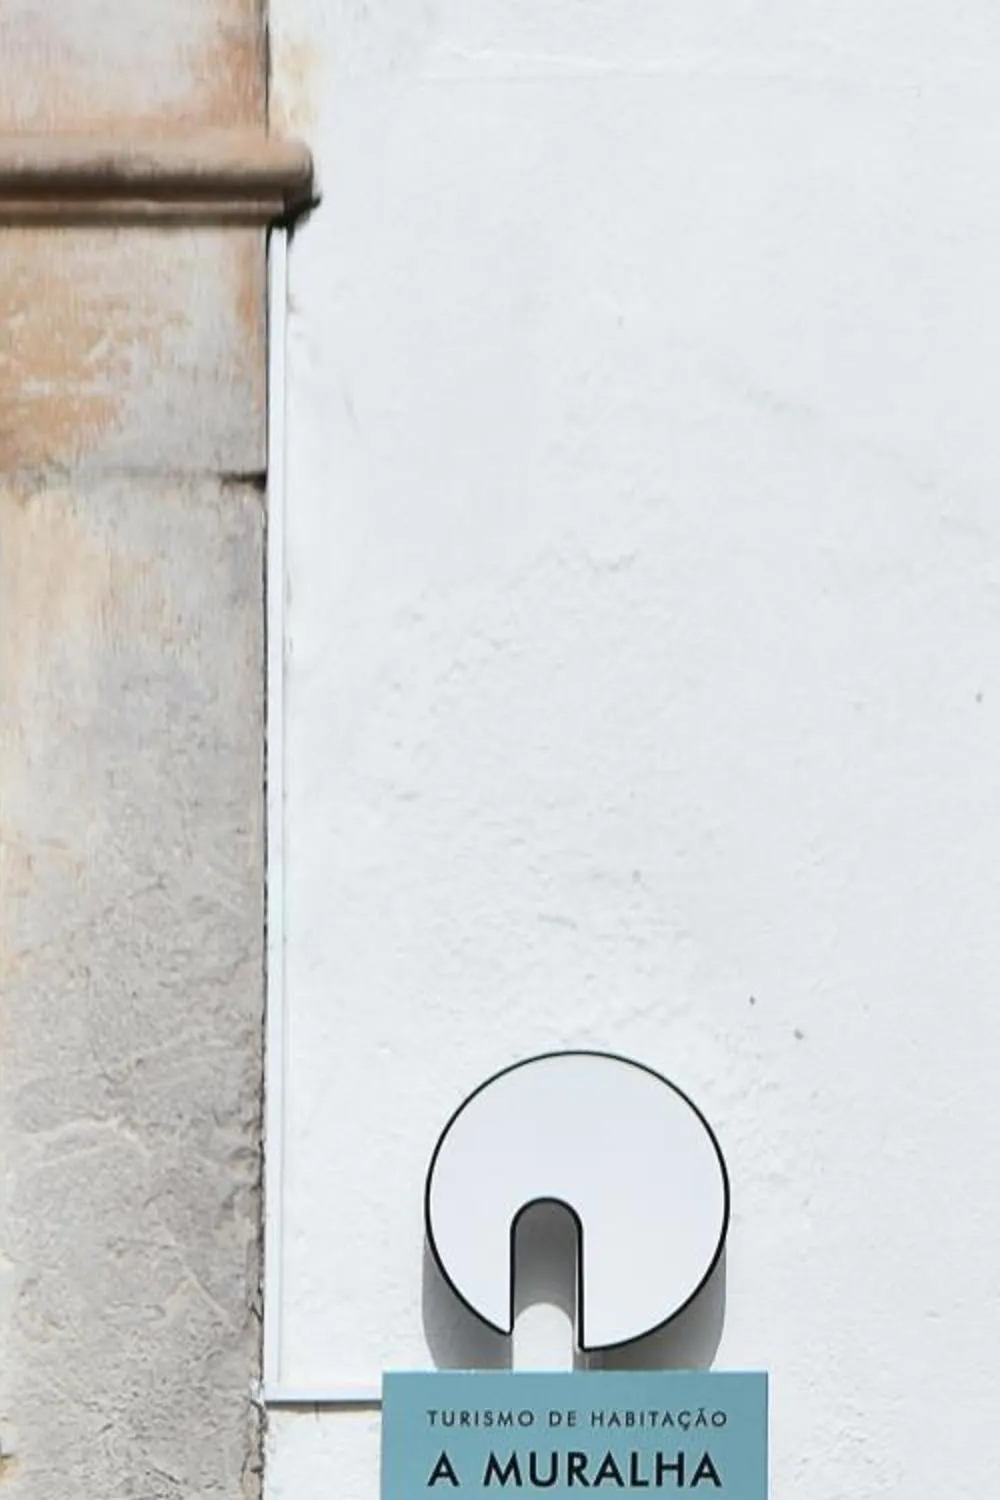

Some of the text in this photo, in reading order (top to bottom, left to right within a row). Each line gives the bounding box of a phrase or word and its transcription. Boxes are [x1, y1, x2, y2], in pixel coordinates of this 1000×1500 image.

[426, 1408, 728, 1432] TURISMO DE HABITAÇÃO
[427, 1451, 723, 1488] A MURALHA
